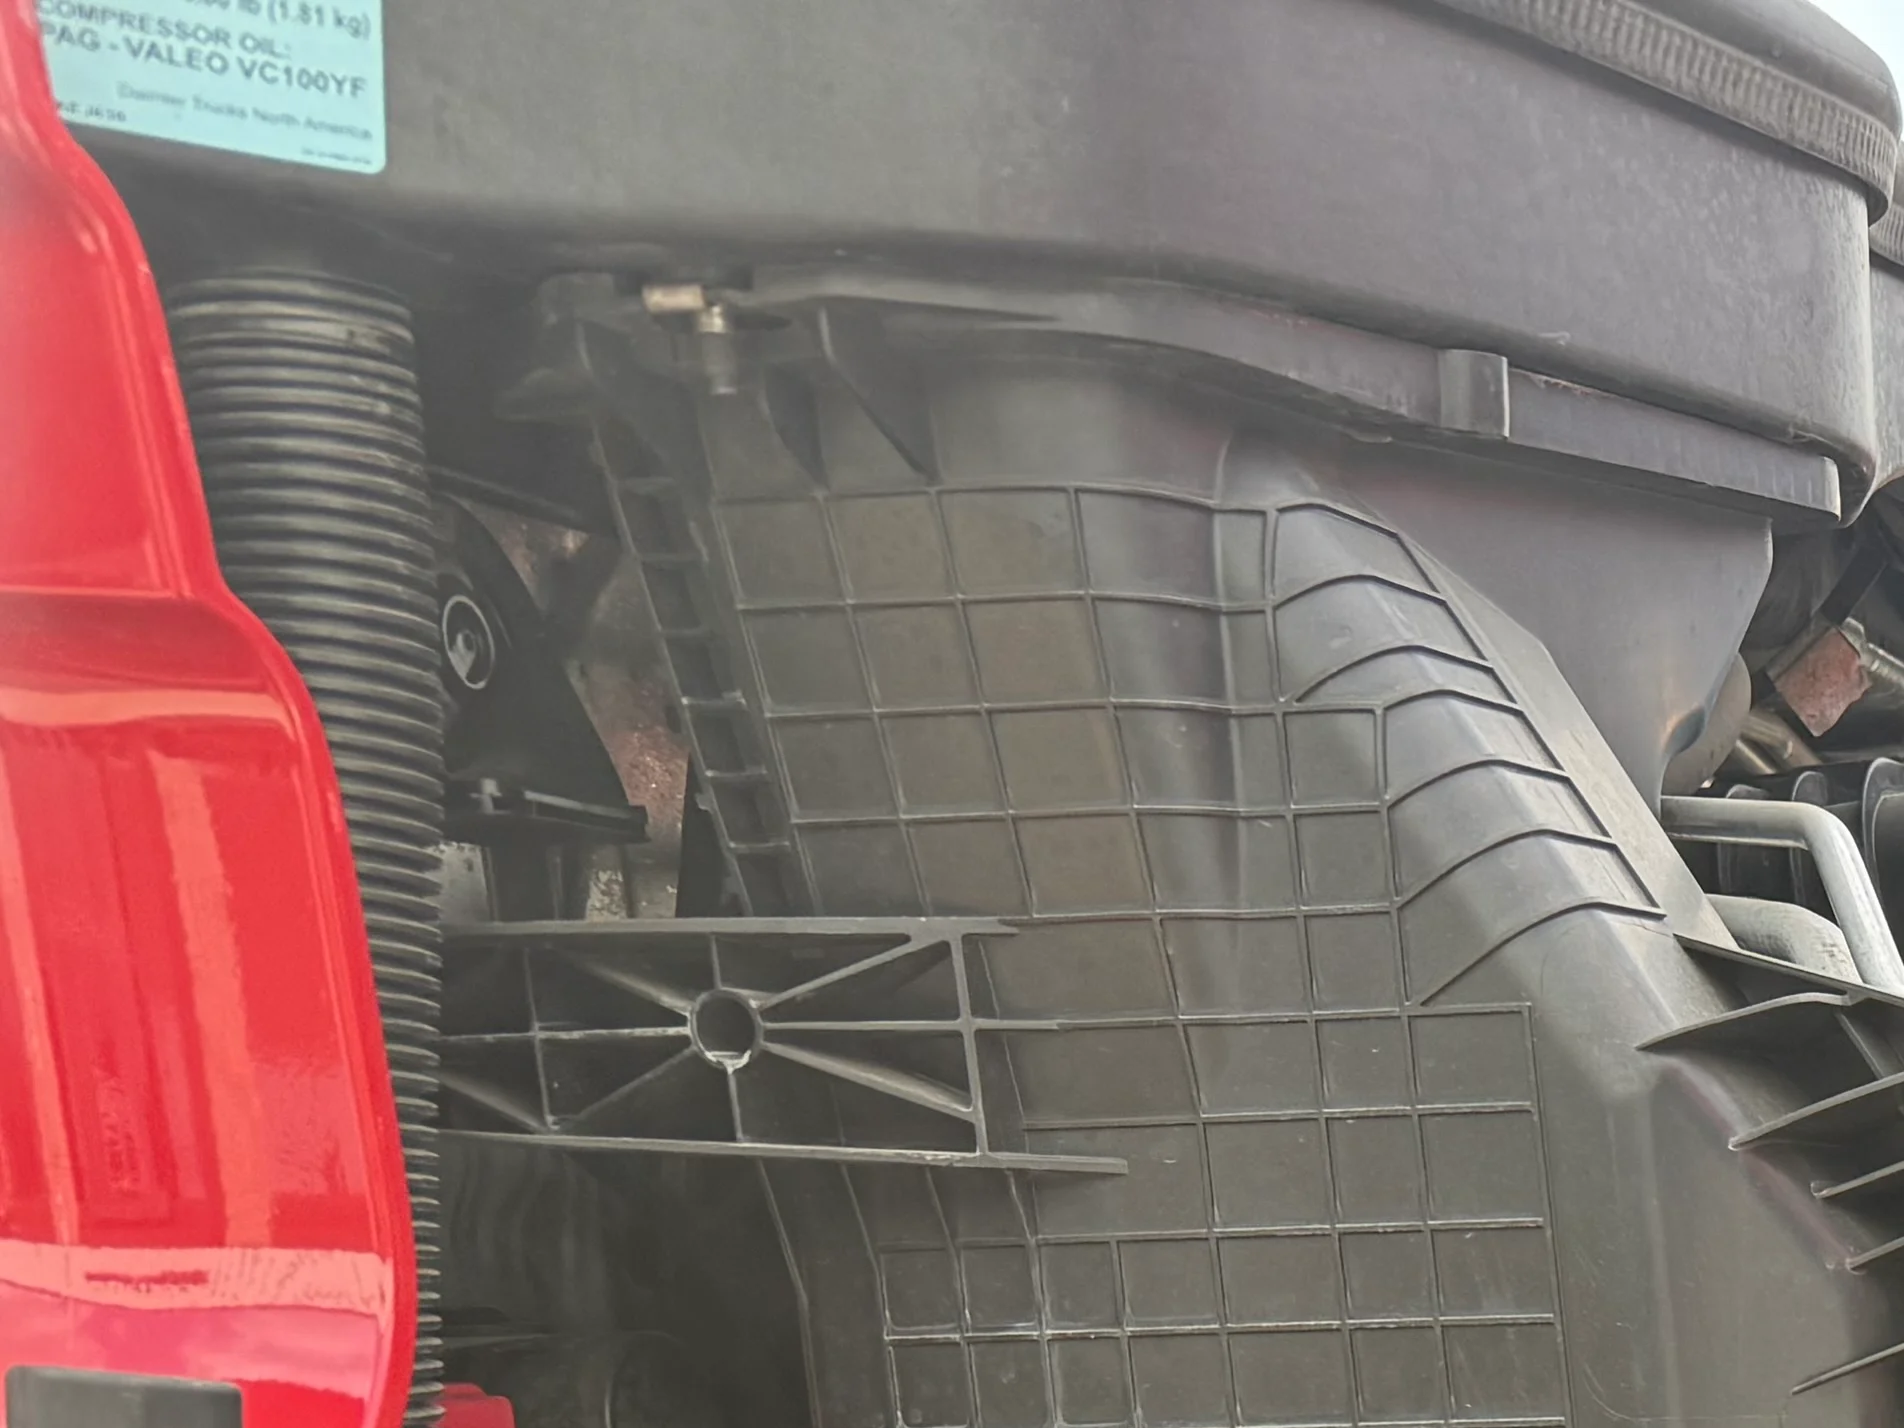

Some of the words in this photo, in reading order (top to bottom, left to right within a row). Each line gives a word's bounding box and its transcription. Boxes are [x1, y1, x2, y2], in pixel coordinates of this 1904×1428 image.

[238, 31, 291, 59] OIL:
[122, 36, 230, 75] VALEO
[236, 56, 368, 98] VC100YF
[251, 106, 301, 128] North
[303, 115, 373, 141] America
